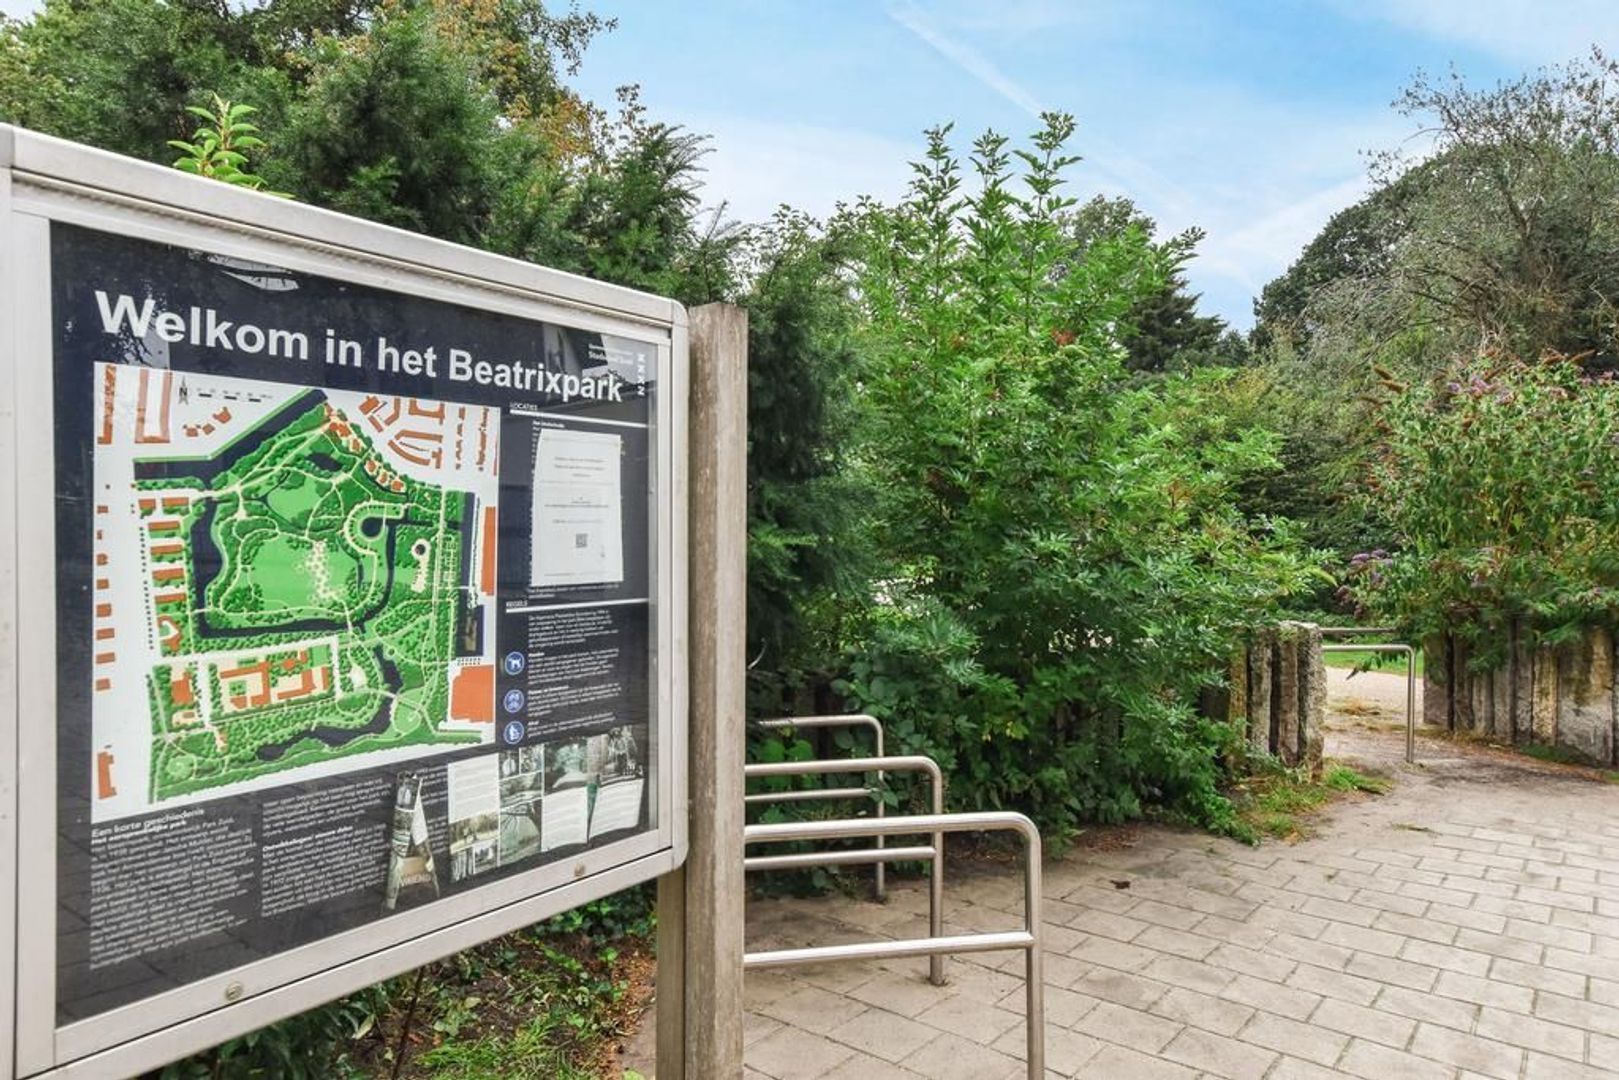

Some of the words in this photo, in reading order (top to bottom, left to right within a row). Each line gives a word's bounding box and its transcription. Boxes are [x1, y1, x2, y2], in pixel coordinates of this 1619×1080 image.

[95, 290, 308, 360] Welkom
[325, 329, 362, 367] in
[377, 337, 437, 377] het
[449, 348, 623, 403] Beatrixpark
